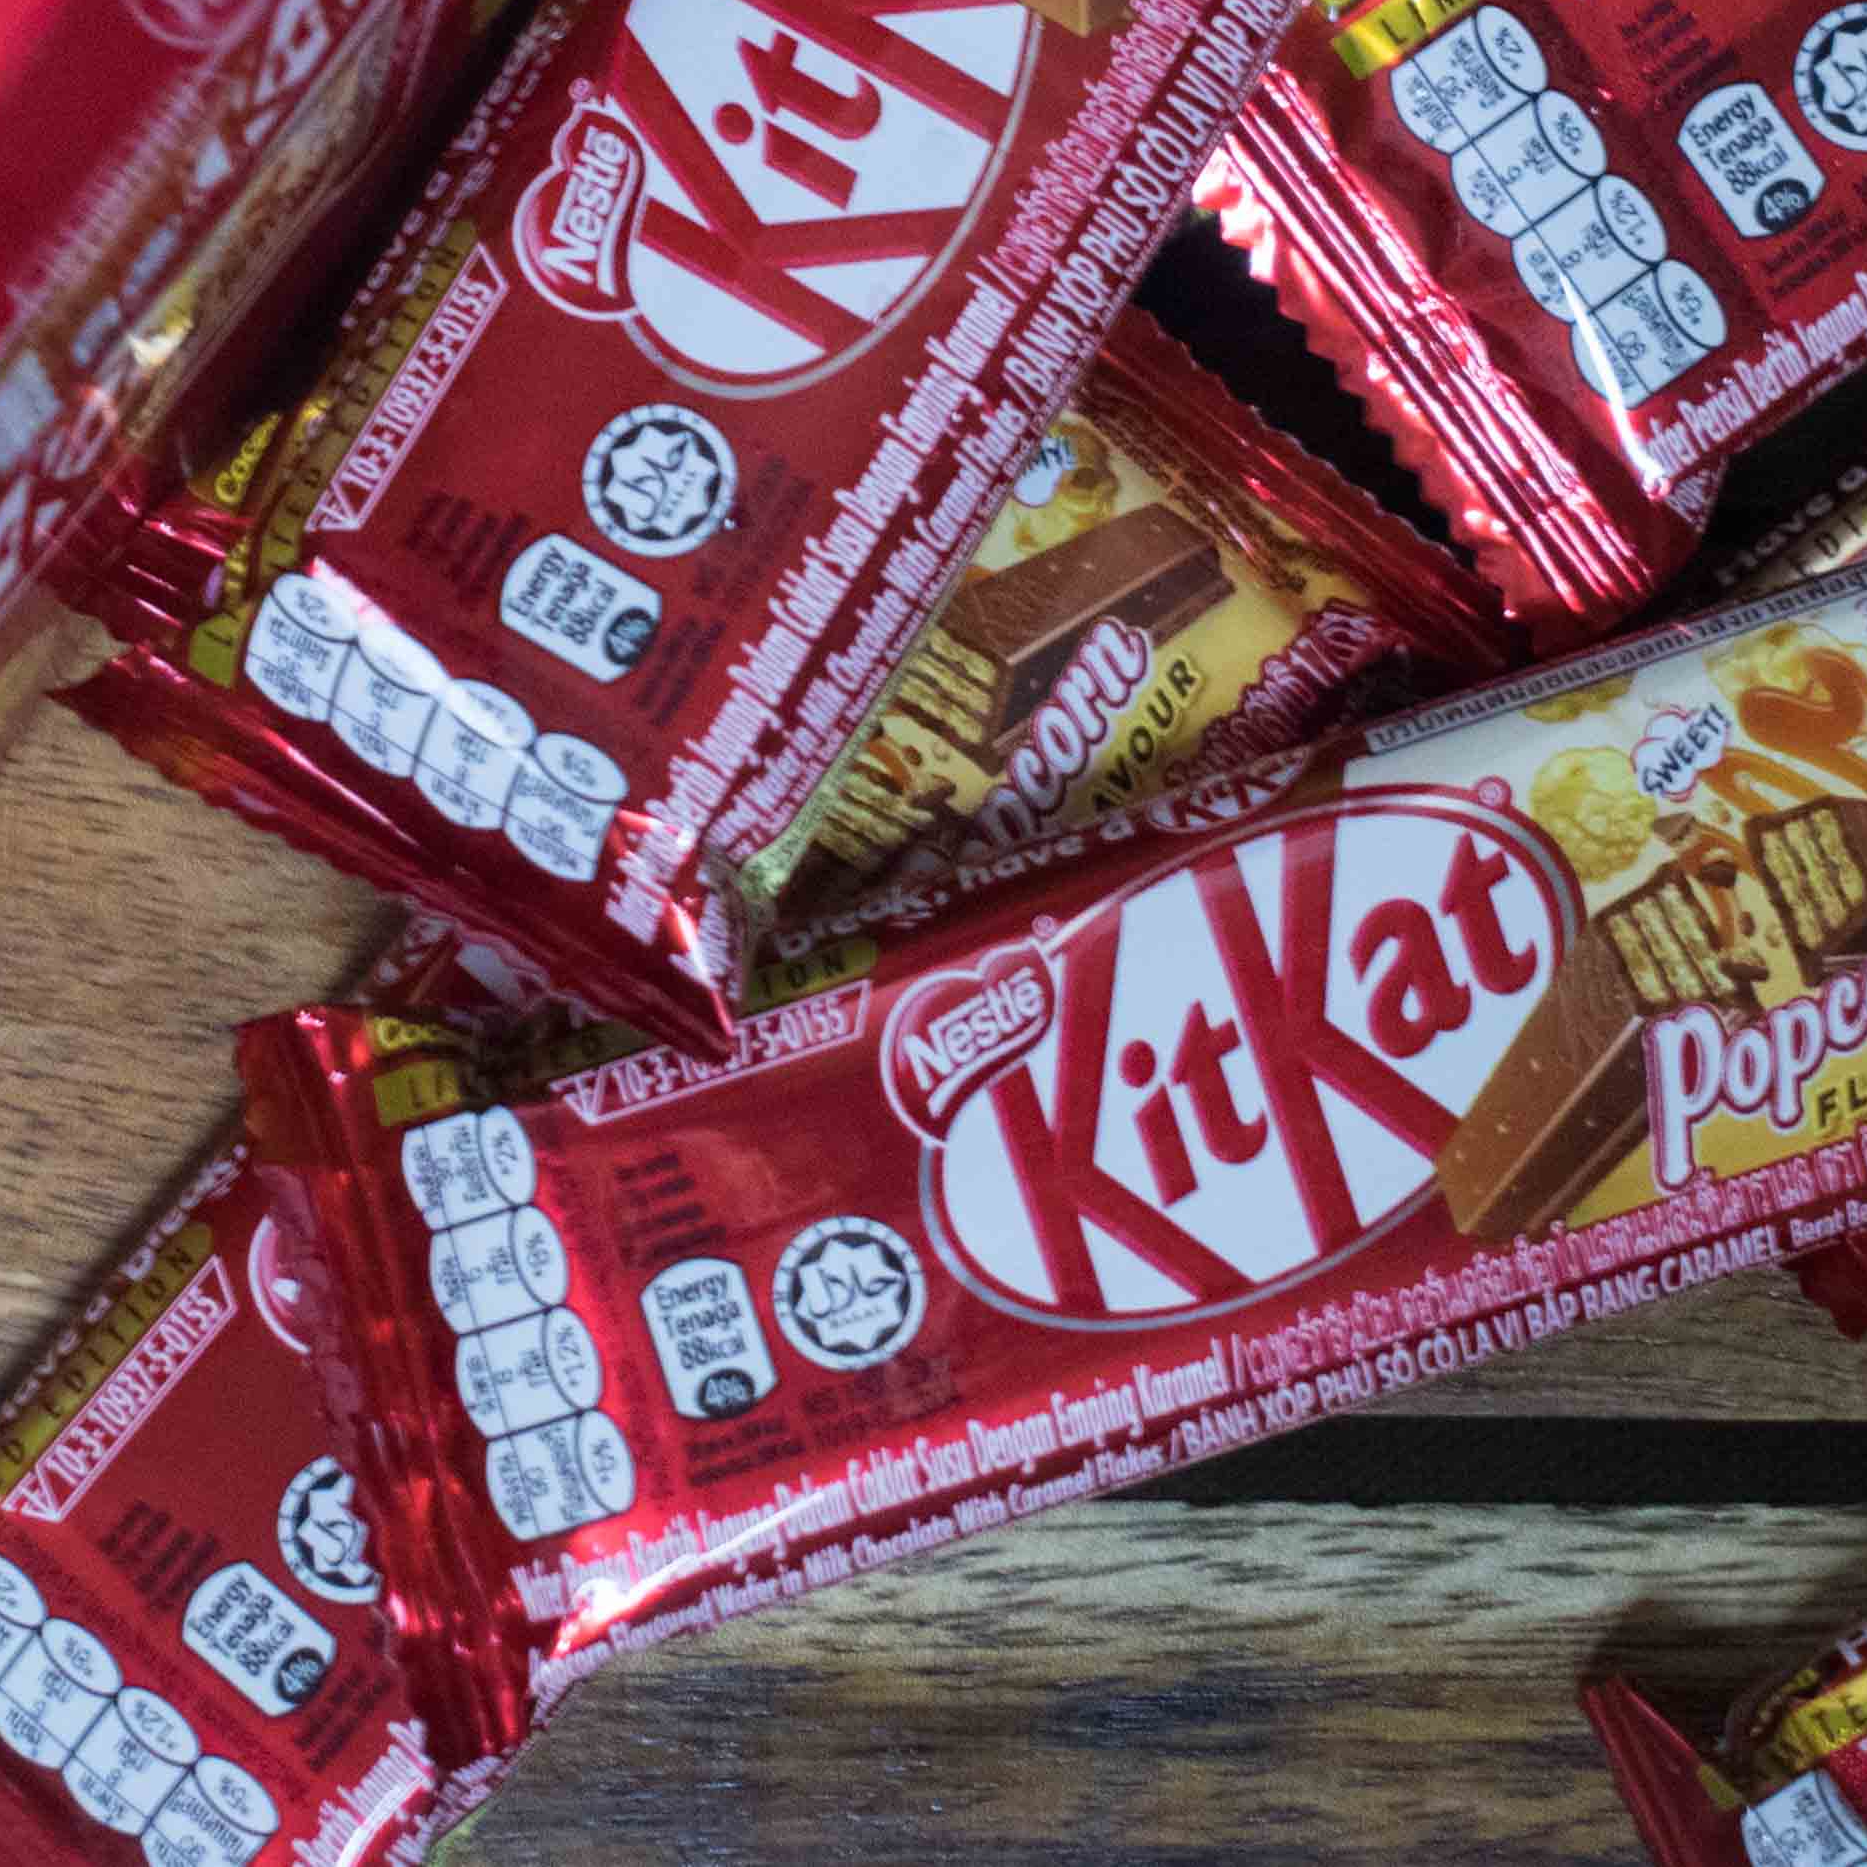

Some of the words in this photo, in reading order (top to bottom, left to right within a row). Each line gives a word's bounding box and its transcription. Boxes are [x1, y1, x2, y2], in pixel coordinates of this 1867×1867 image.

[1684, 85, 1763, 156] Energy
[1703, 108, 1781, 179] Tenaga
[541, 125, 633, 289] Nestlé
[1035, 245, 1119, 325] XỐP
[1154, 91, 1214, 146] LA
[1722, 136, 1793, 200] 88kcal
[1759, 180, 1806, 225] 4%
[920, 269, 1021, 382] Karamel
[340, 270, 498, 500] 10-3-10937-5-0155
[875, 353, 987, 465] Emping
[1672, 367, 1757, 450] Perisa
[959, 392, 1028, 472] Flakes
[828, 427, 937, 539] Dengan
[908, 453, 994, 555] Caramel
[505, 538, 576, 626] Energy
[800, 501, 881, 579] Susu
[878, 534, 944, 601] With
[530, 553, 602, 643] Tenaga
[557, 572, 623, 652] 88kcal
[763, 548, 852, 640] Coklat
[821, 579, 918, 697] Chocolate
[723, 612, 814, 707] Dalam
[681, 677, 787, 786] Jagung
[792, 675, 857, 740] Milk
[1644, 706, 1731, 797] SWEET!
[608, 996, 852, 1108] 10-3-17-5-0155
[904, 967, 1045, 1090] Nestlé
[987, 827, 1539, 1314] KitKat
[649, 1265, 734, 1318] Energy
[1653, 1222, 1784, 1294] CARAMEL
[32, 1241, 202, 1420] EDITION
[658, 1294, 746, 1347] Tenaga
[672, 1323, 750, 1376] 88kcal
[36, 1285, 231, 1489] 10-3-10937-5-0155
[909, 1423, 977, 1496] Susu
[962, 1394, 1064, 1489] Dengan
[1046, 1366, 1147, 1458] Emping
[1129, 1336, 1236, 1421] Karamel
[188, 1571, 257, 1642] Energy
[208, 1588, 278, 1661] Tenaga
[234, 1611, 300, 1678] 88kcal
